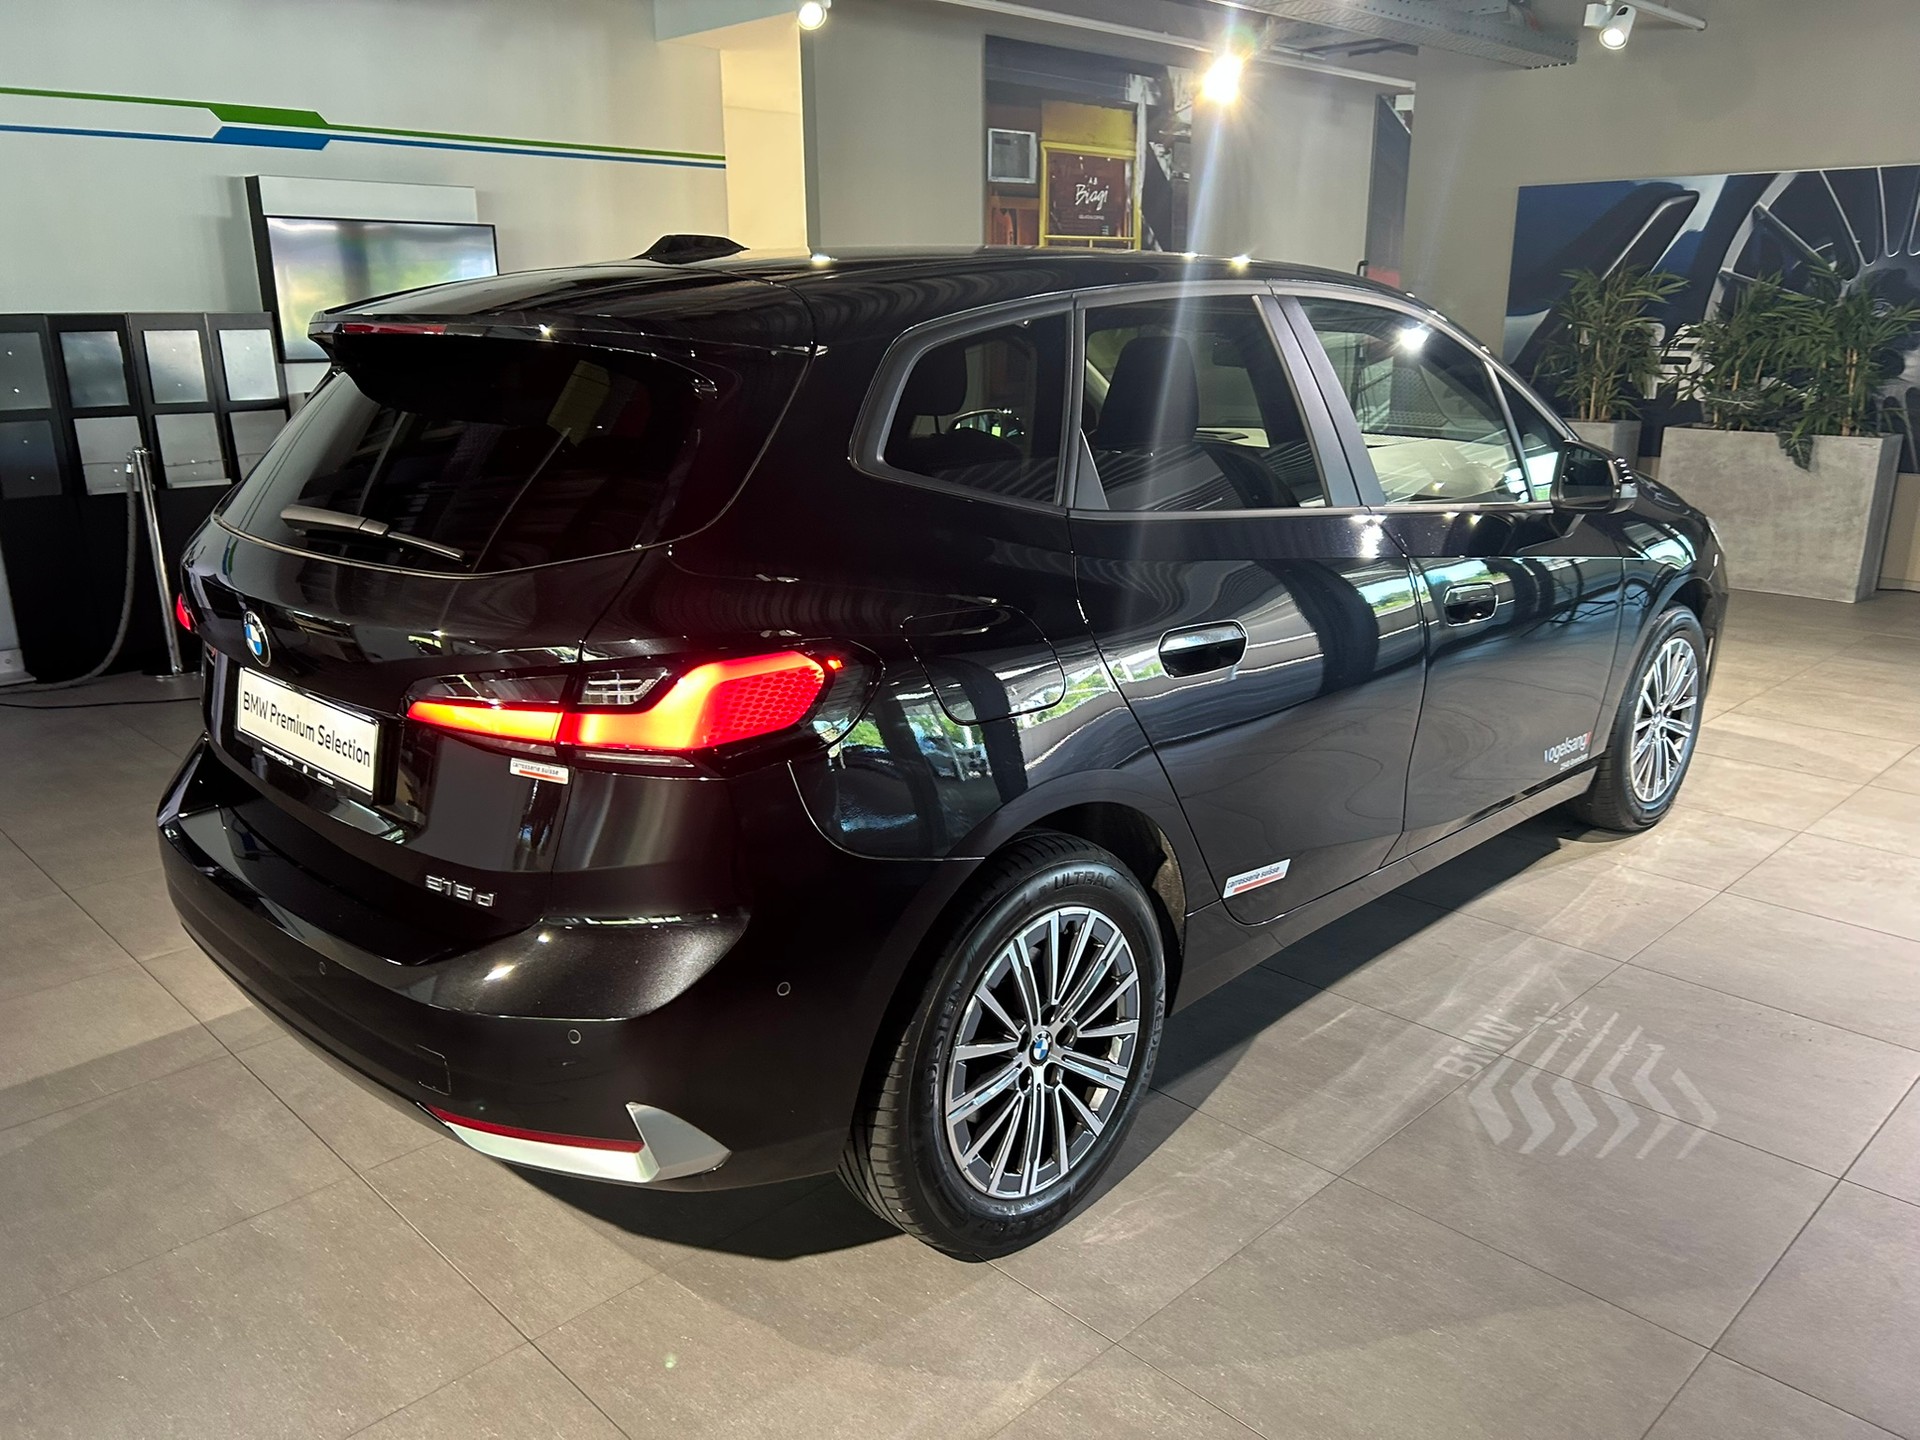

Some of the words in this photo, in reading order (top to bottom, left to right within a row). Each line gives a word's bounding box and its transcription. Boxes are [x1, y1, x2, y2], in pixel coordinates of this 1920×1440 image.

[1075, 184, 1109, 211] Biagi
[243, 690, 269, 720] BMW
[269, 703, 315, 742] Premium
[317, 724, 371, 768] Selection
[1053, 871, 1117, 890] ULTRAC
[1433, 1013, 1523, 1078] BMW
